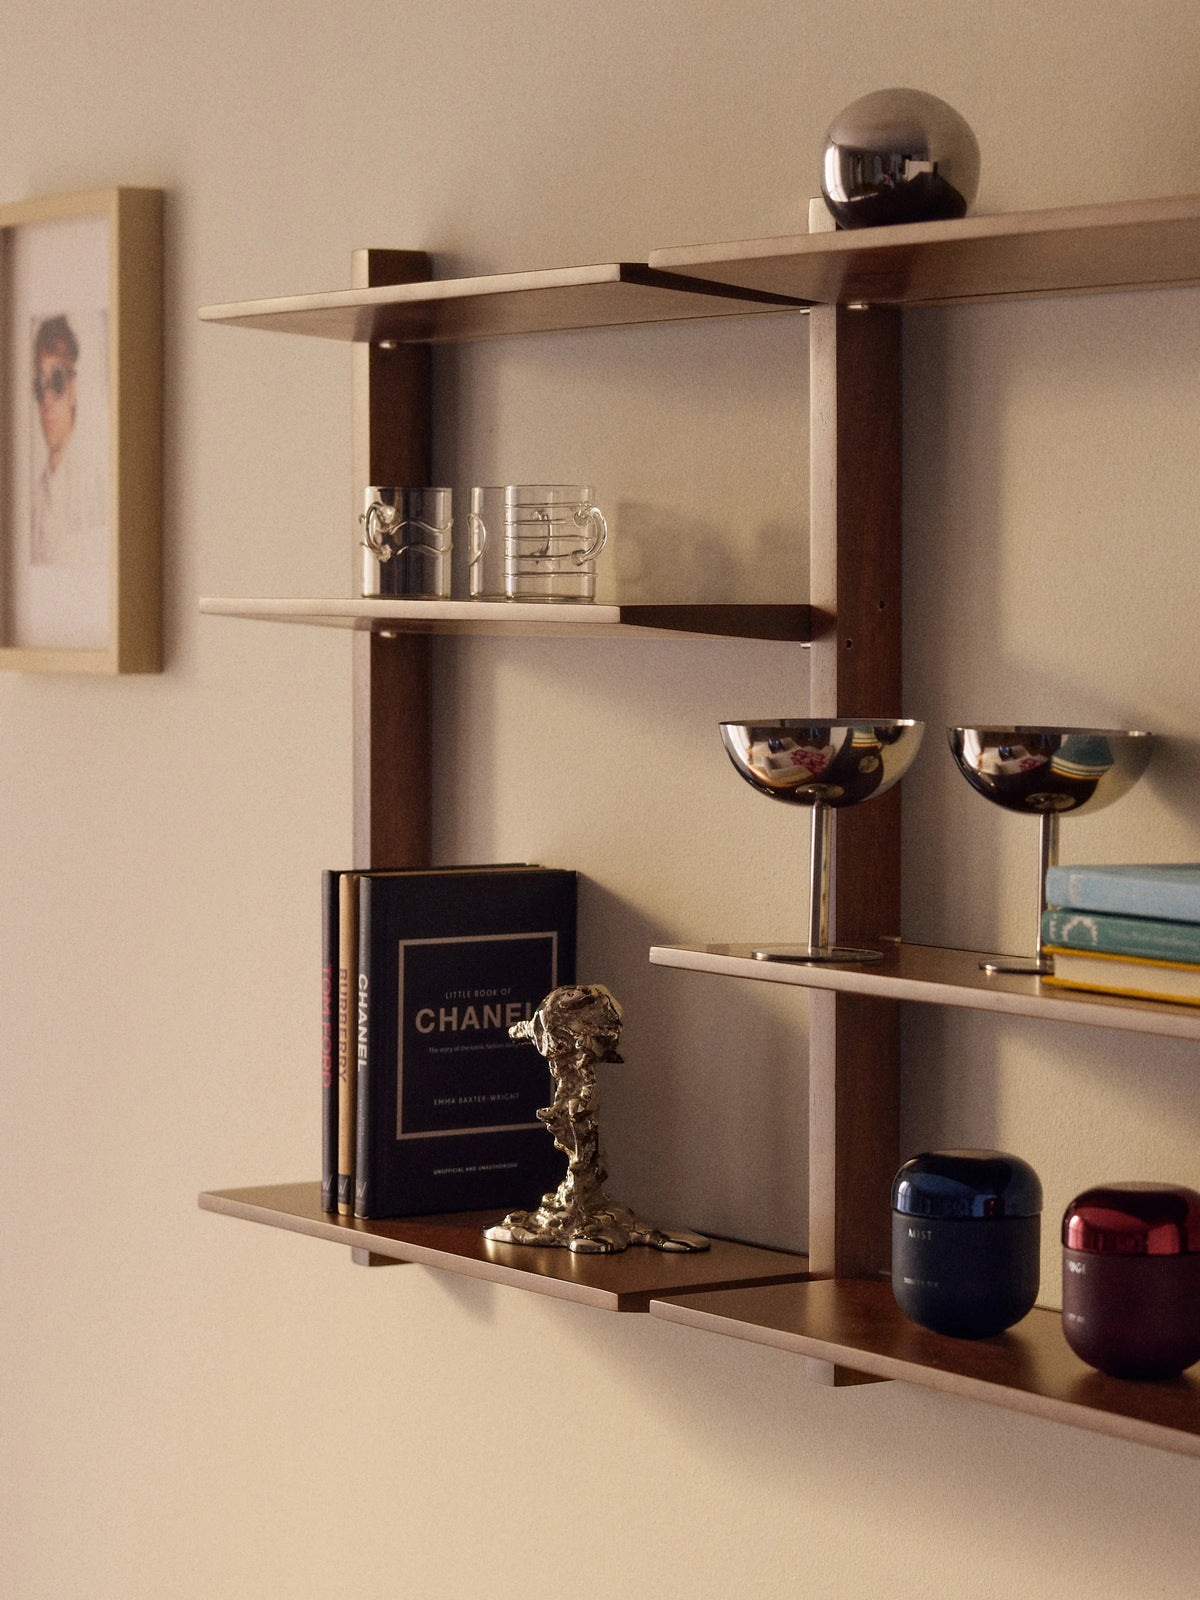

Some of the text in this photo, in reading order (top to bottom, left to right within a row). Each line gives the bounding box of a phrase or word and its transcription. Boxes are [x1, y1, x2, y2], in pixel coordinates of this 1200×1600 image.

[321, 964, 332, 1015] TOM
[445, 987, 512, 1000] LITTLE BOOK OF
[339, 968, 348, 1083] BURBERRY
[357, 973, 369, 1073] CHANEL
[321, 1021, 332, 1088] FORD
[433, 1098, 456, 1106] EMMA
